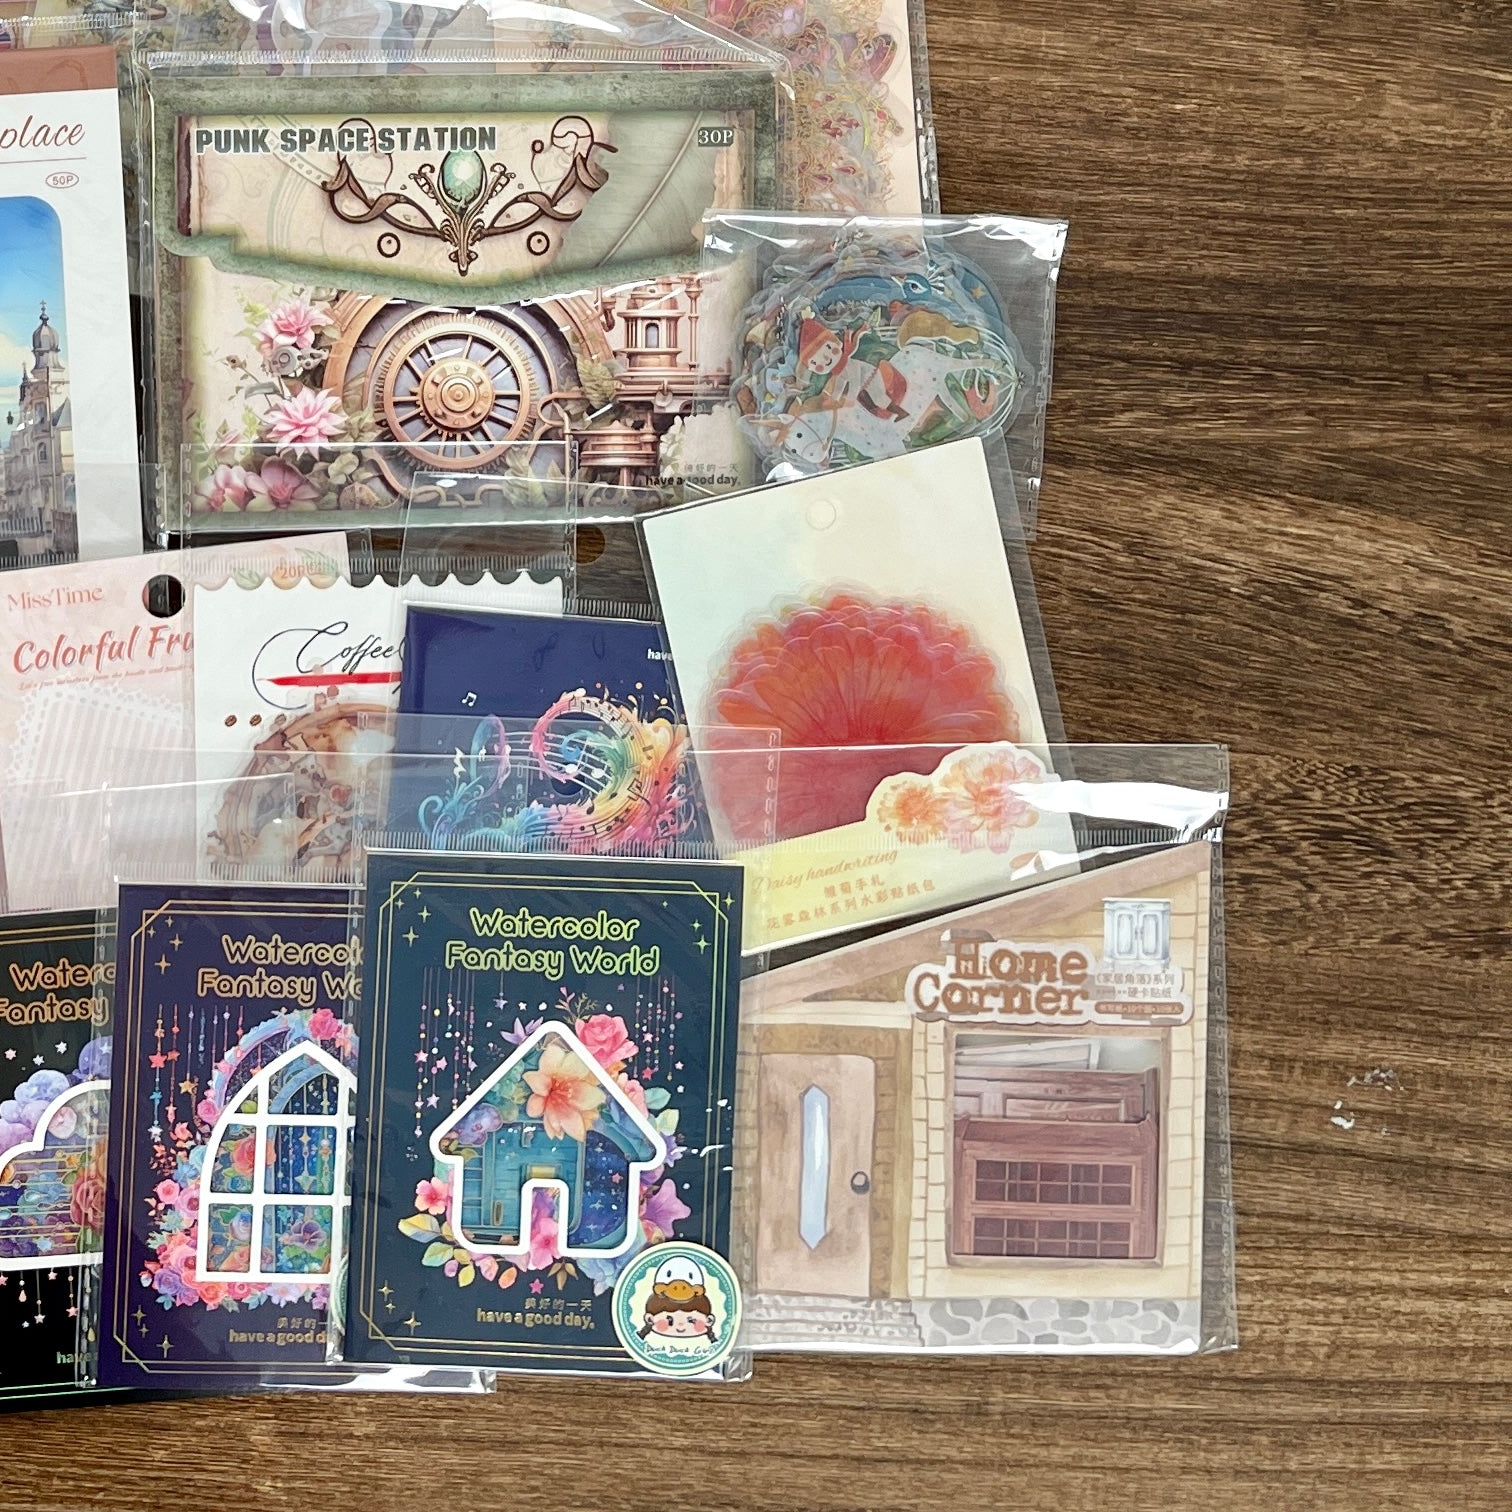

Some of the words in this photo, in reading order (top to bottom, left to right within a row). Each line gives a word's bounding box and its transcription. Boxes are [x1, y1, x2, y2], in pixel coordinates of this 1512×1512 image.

[195, 128, 271, 154] PUNK
[280, 127, 370, 153] SPACE
[377, 126, 496, 152] STATION
[52, 175, 74, 186] 50P
[645, 475, 674, 485] have
[677, 477, 684, 485] a
[13, 625, 141, 673] Colorful
[469, 906, 640, 941] Watercolor
[445, 940, 565, 981] Fantasy
[569, 945, 660, 976] World
[949, 938, 1088, 984] Home
[197, 967, 316, 1007] Fantasy
[914, 972, 1088, 1015] Corner
[476, 1308, 512, 1323] have
[513, 1312, 523, 1323] a
[524, 1311, 563, 1328] good
[564, 1312, 595, 1329] day.
[229, 1329, 264, 1343] have
[266, 1332, 275, 1343] a
[277, 1330, 314, 1346] good
